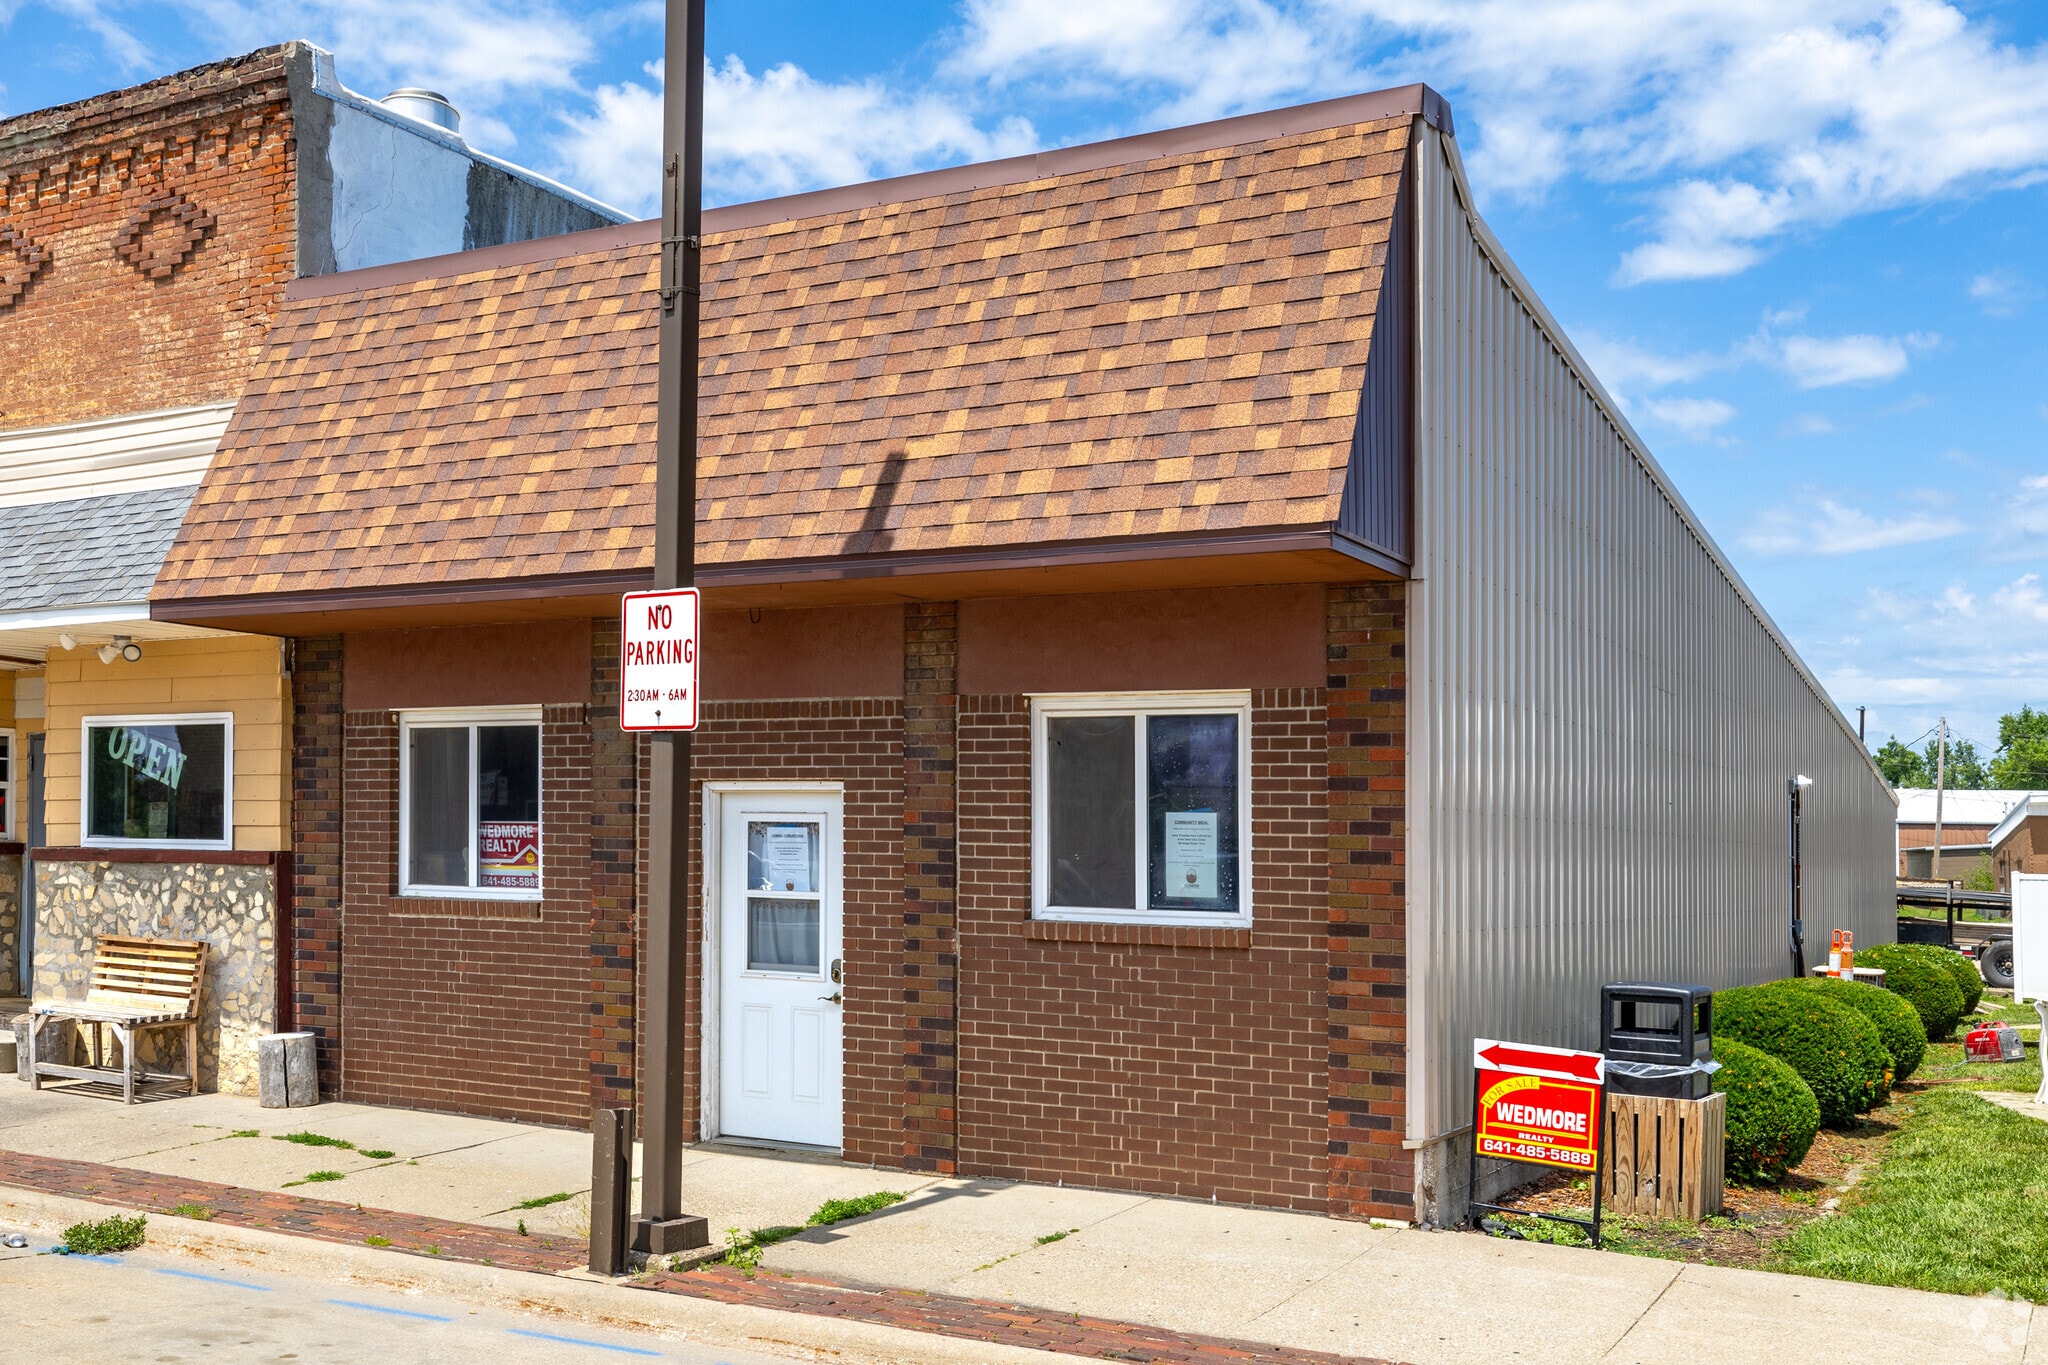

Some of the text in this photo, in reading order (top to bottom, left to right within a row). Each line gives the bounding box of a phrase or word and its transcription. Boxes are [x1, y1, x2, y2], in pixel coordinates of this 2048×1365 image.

[648, 604, 672, 630] NO
[627, 638, 693, 666] PARKING
[668, 688, 687, 701] 6AM
[108, 726, 187, 790] OPEN
[480, 825, 534, 838] WEDMORE
[480, 839, 521, 852] REALTY
[1483, 1078, 1537, 1106] FOR SALE
[1496, 1101, 1587, 1133] WEDMORE
[1518, 1132, 1554, 1143] REALTY
[1483, 1139, 1591, 1165] 641-485-5889
